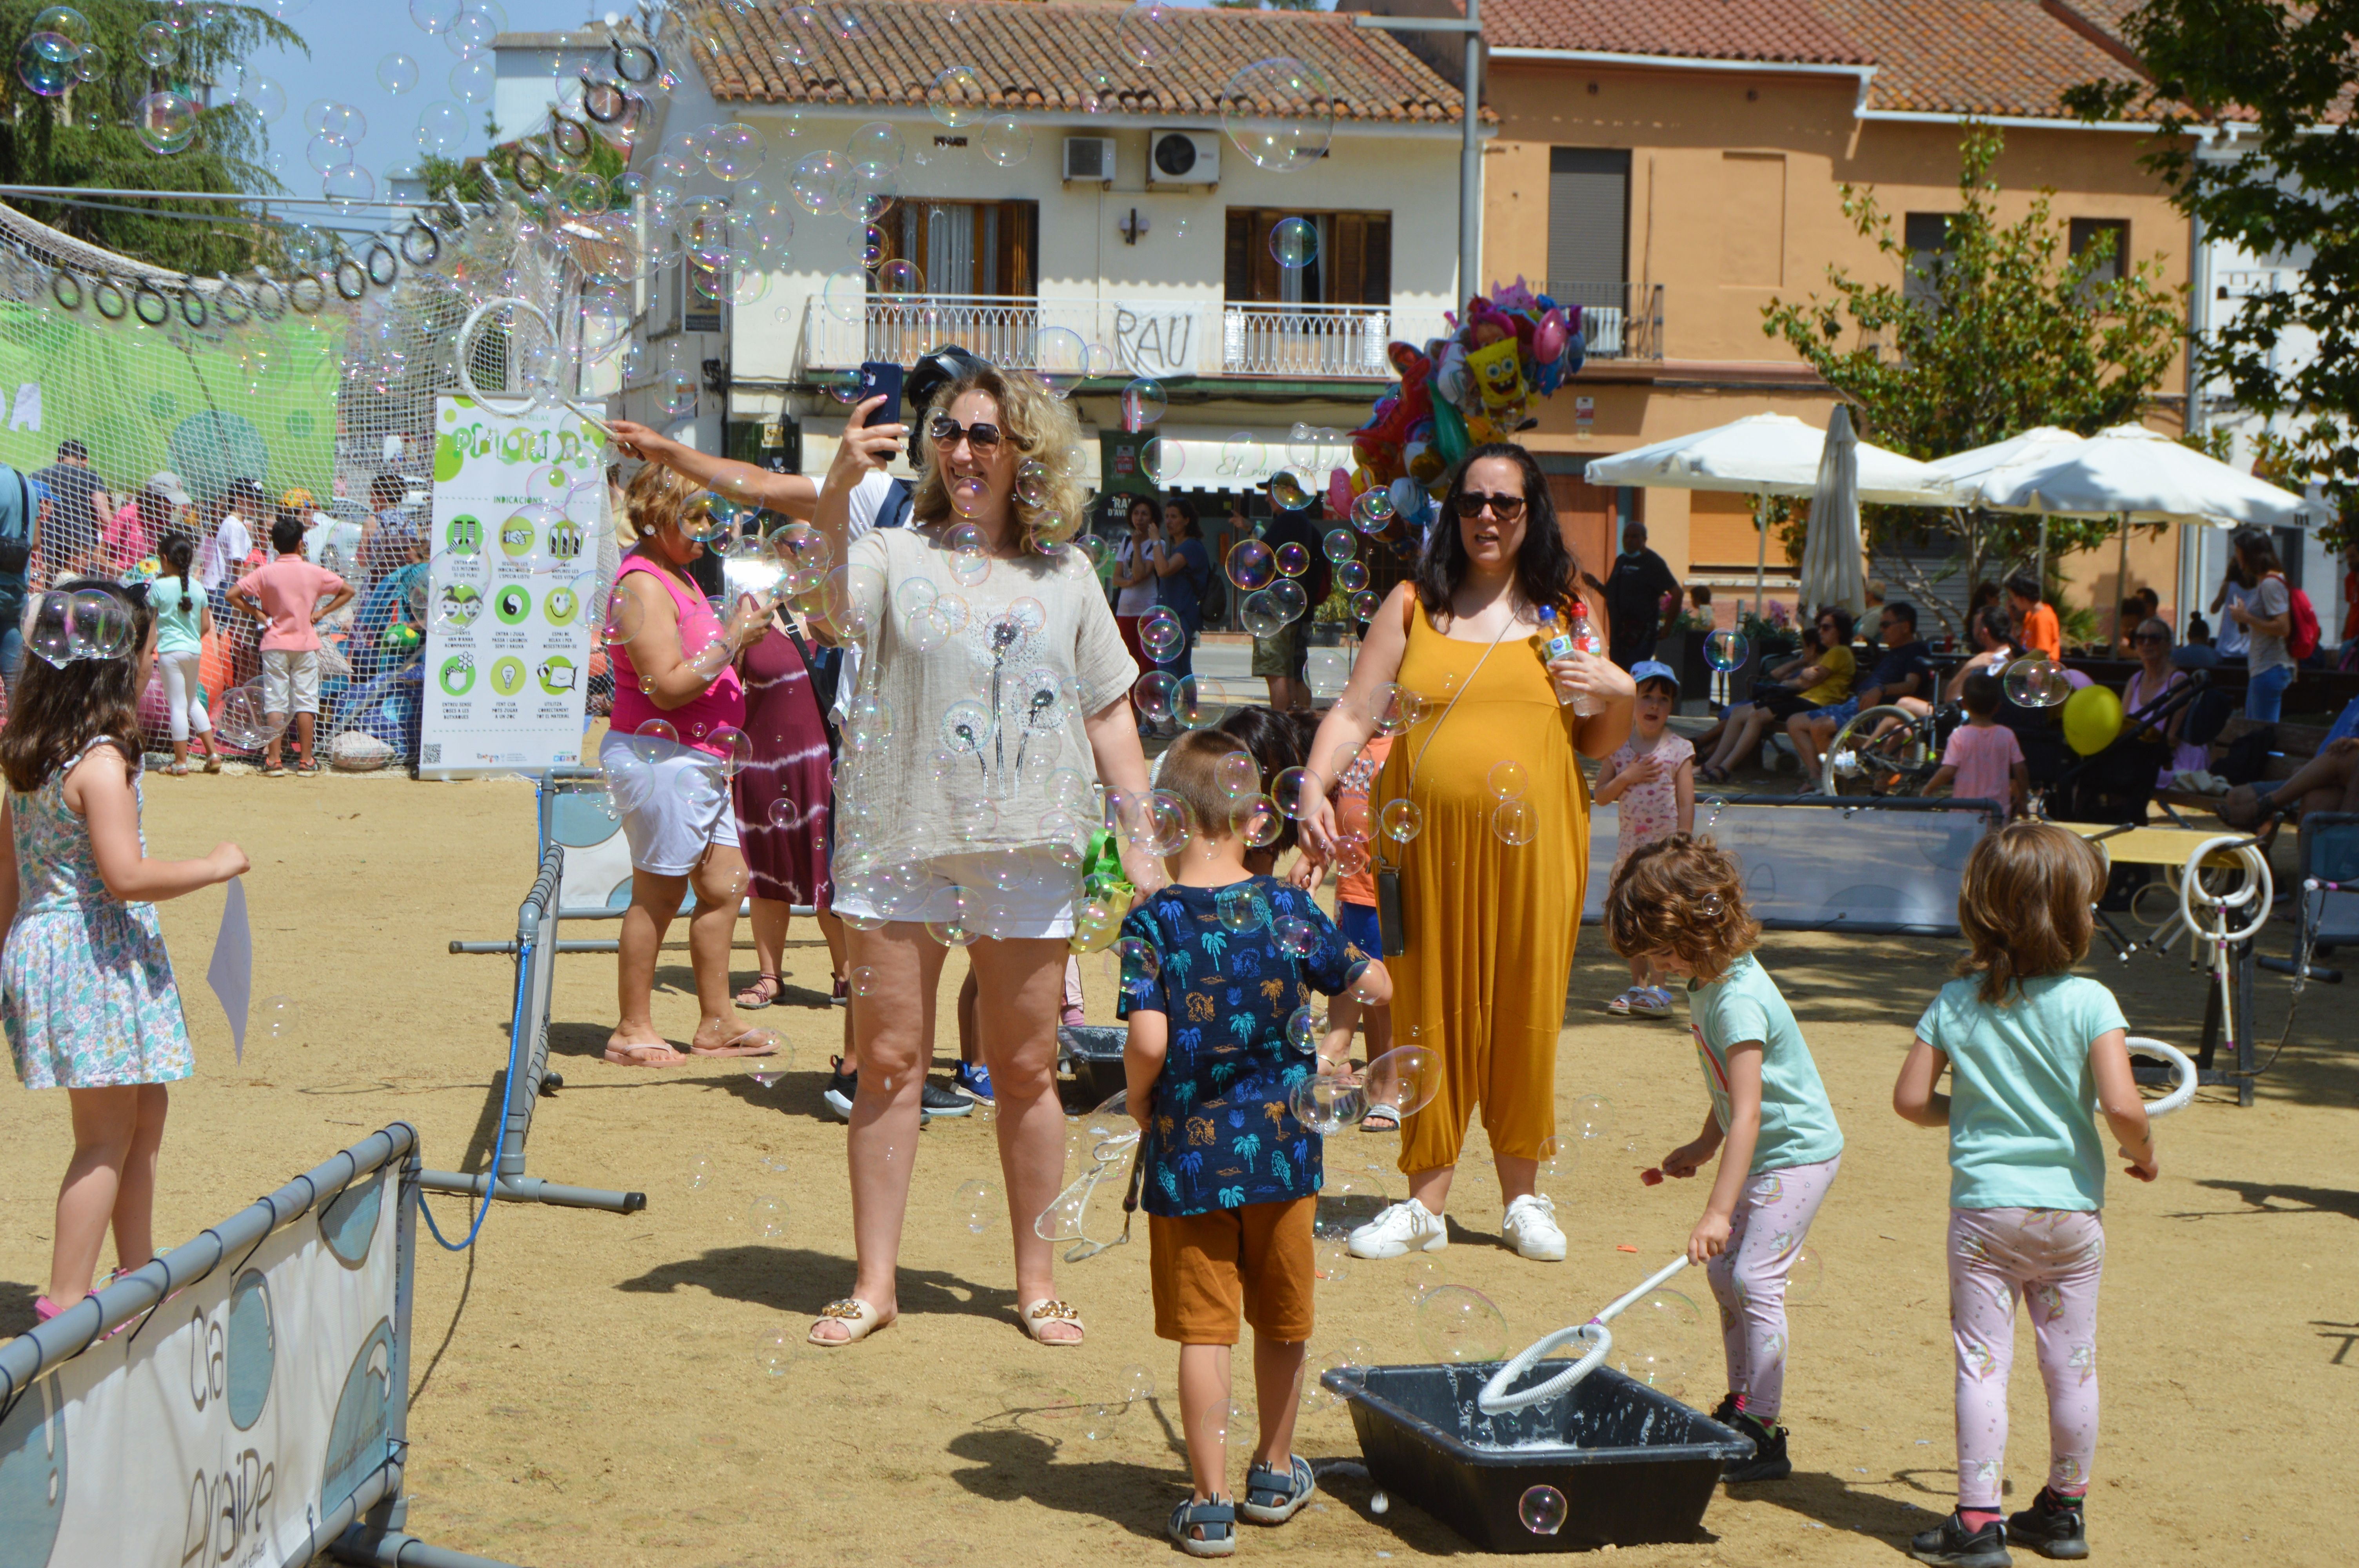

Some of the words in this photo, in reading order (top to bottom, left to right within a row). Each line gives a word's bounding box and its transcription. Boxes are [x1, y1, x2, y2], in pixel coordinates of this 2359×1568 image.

[1216, 455, 1244, 476] El
[494, 495, 543, 504] INDICACIONS
[1108, 508, 1126, 517] D'AVI
[191, 1305, 223, 1412] Cia
